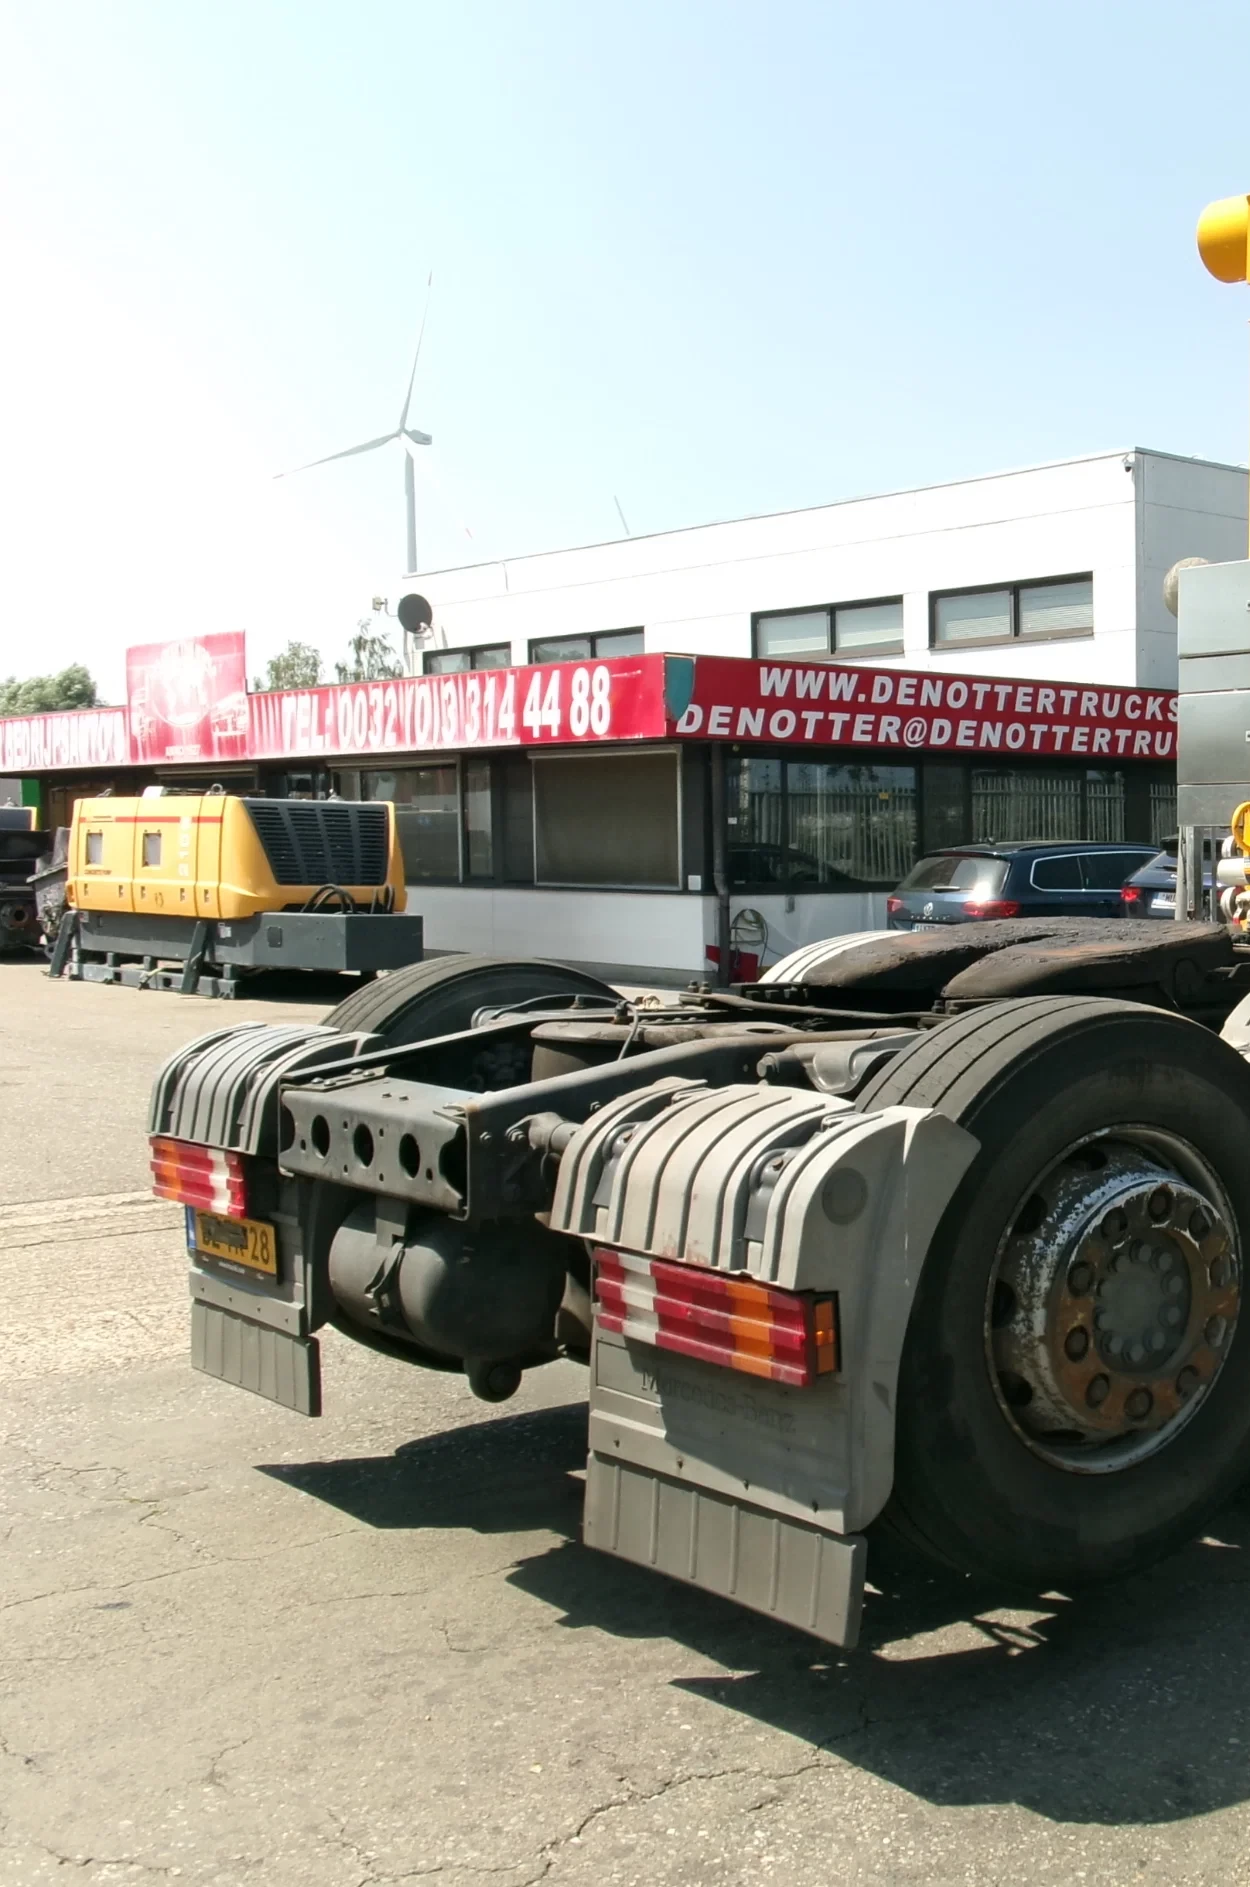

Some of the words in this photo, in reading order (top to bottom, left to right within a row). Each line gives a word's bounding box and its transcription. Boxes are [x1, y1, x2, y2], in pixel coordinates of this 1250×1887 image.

[338, 685, 398, 750] 0032
[464, 674, 516, 742] 314
[522, 669, 562, 739] 44
[569, 664, 611, 737] 88
[675, 703, 1178, 757] DENOTTER@DENOTTERTRU
